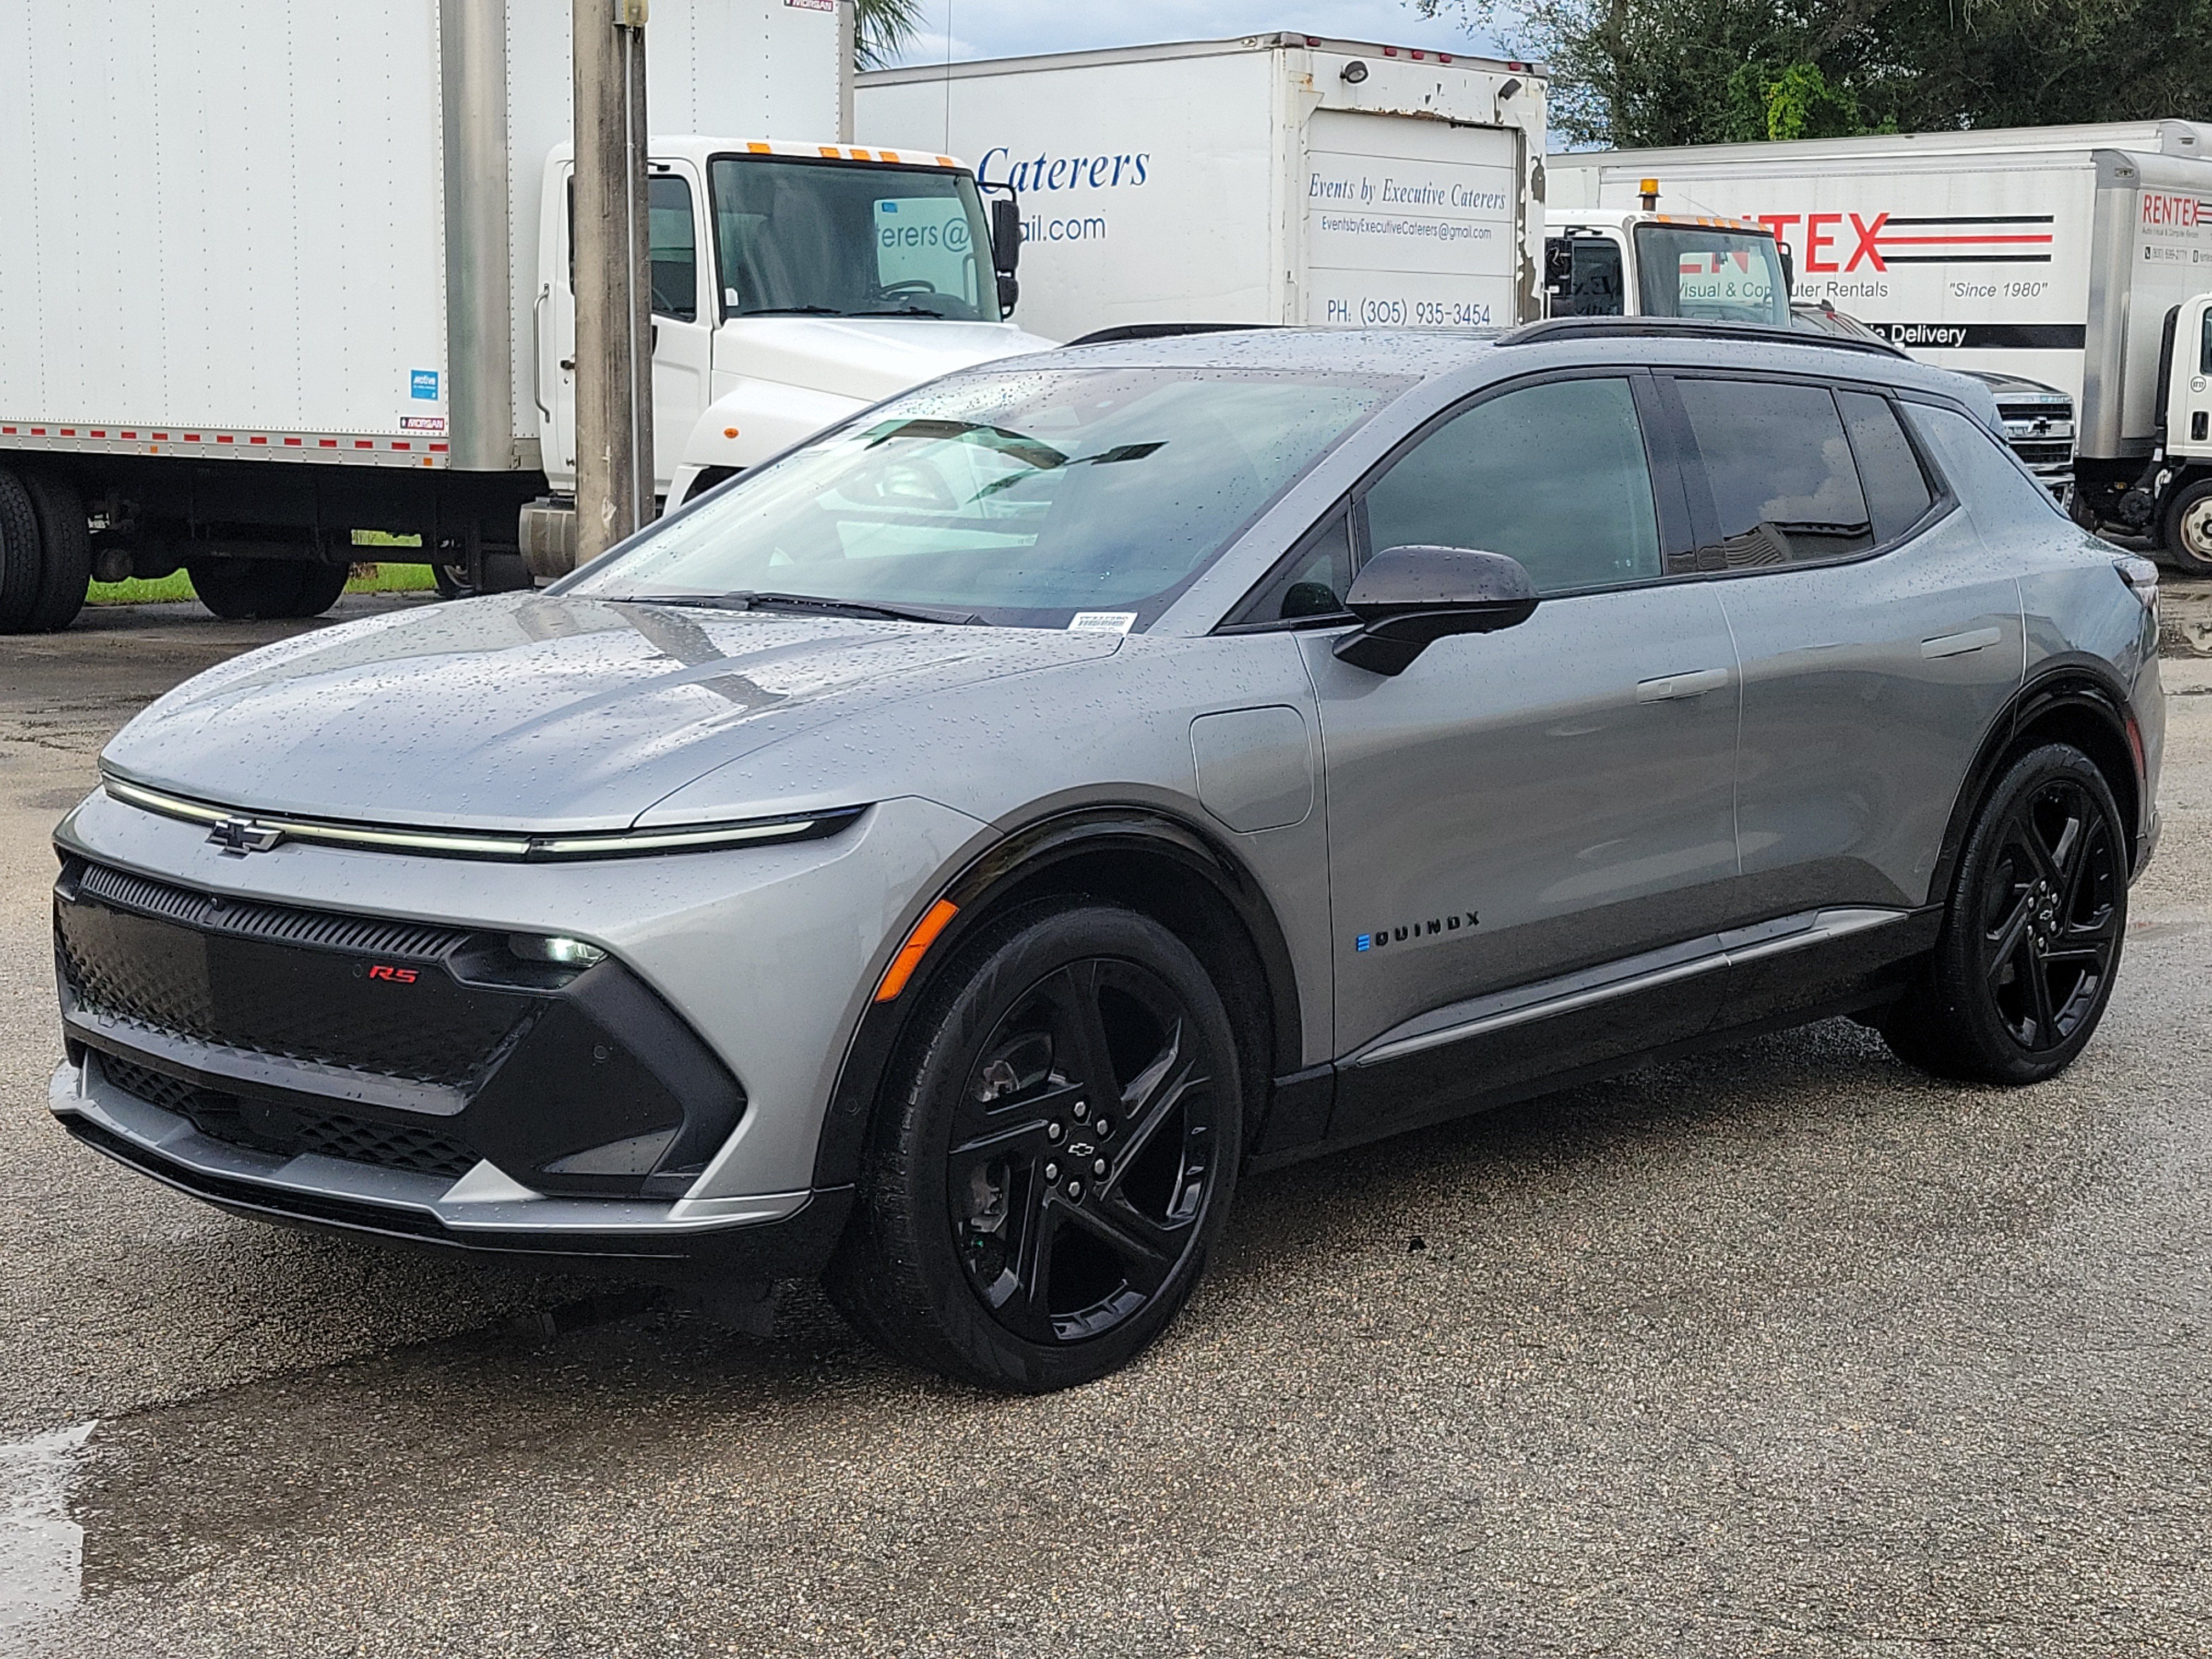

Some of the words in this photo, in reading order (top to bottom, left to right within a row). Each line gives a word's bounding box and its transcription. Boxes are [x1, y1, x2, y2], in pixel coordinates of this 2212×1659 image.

[978, 147, 1150, 195] Caterers
[1309, 173, 1355, 200] Events
[1361, 177, 1375, 205] by
[1383, 178, 1445, 205] Executive
[1451, 184, 1506, 210] Caterers
[2143, 194, 2200, 227] RENTEX
[1827, 281, 1888, 298] Rentals
[1328, 300, 1351, 322] PH:
[1361, 297, 1407, 325] (305)
[1416, 302, 1491, 325] 935-3454
[1892, 325, 1966, 347] Delivery
[408, 419, 443, 428] MORGAN
[369, 965, 419, 983] RS
